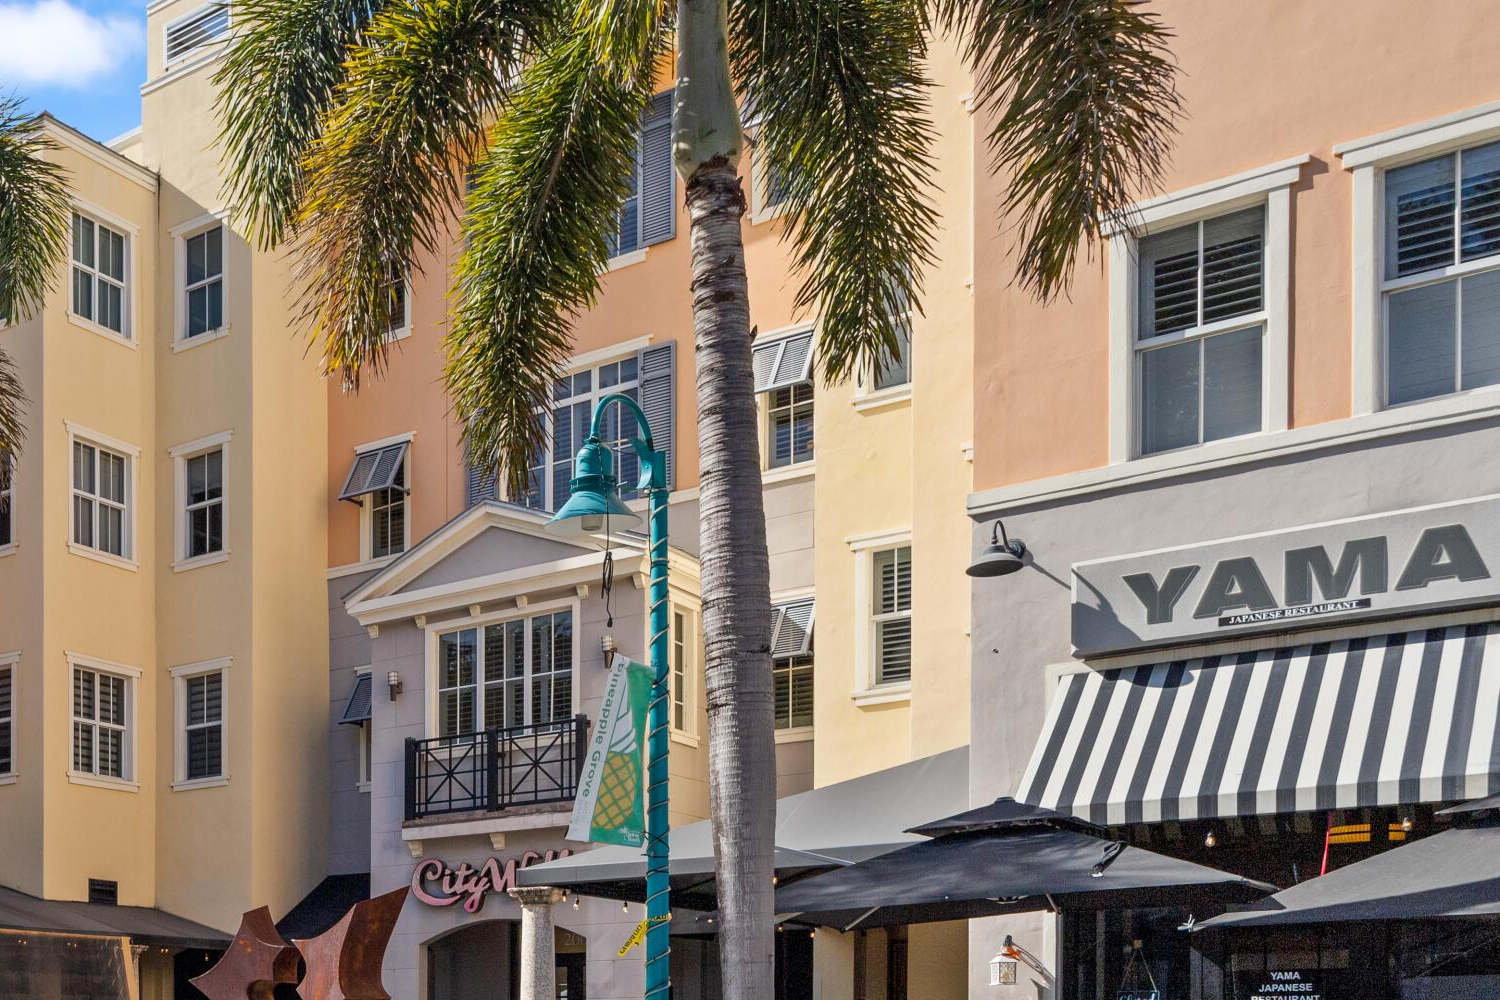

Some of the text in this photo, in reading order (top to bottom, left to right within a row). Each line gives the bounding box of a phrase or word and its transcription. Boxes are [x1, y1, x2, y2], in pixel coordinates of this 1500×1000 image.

[1122, 523, 1492, 626] YAMA
[1229, 600, 1359, 624] JAPANESE RESTAURANT
[582, 662, 625, 798] Pineapple Grove
[1270, 971, 1301, 980] YAMA
[1259, 983, 1313, 993] JAPANESE
